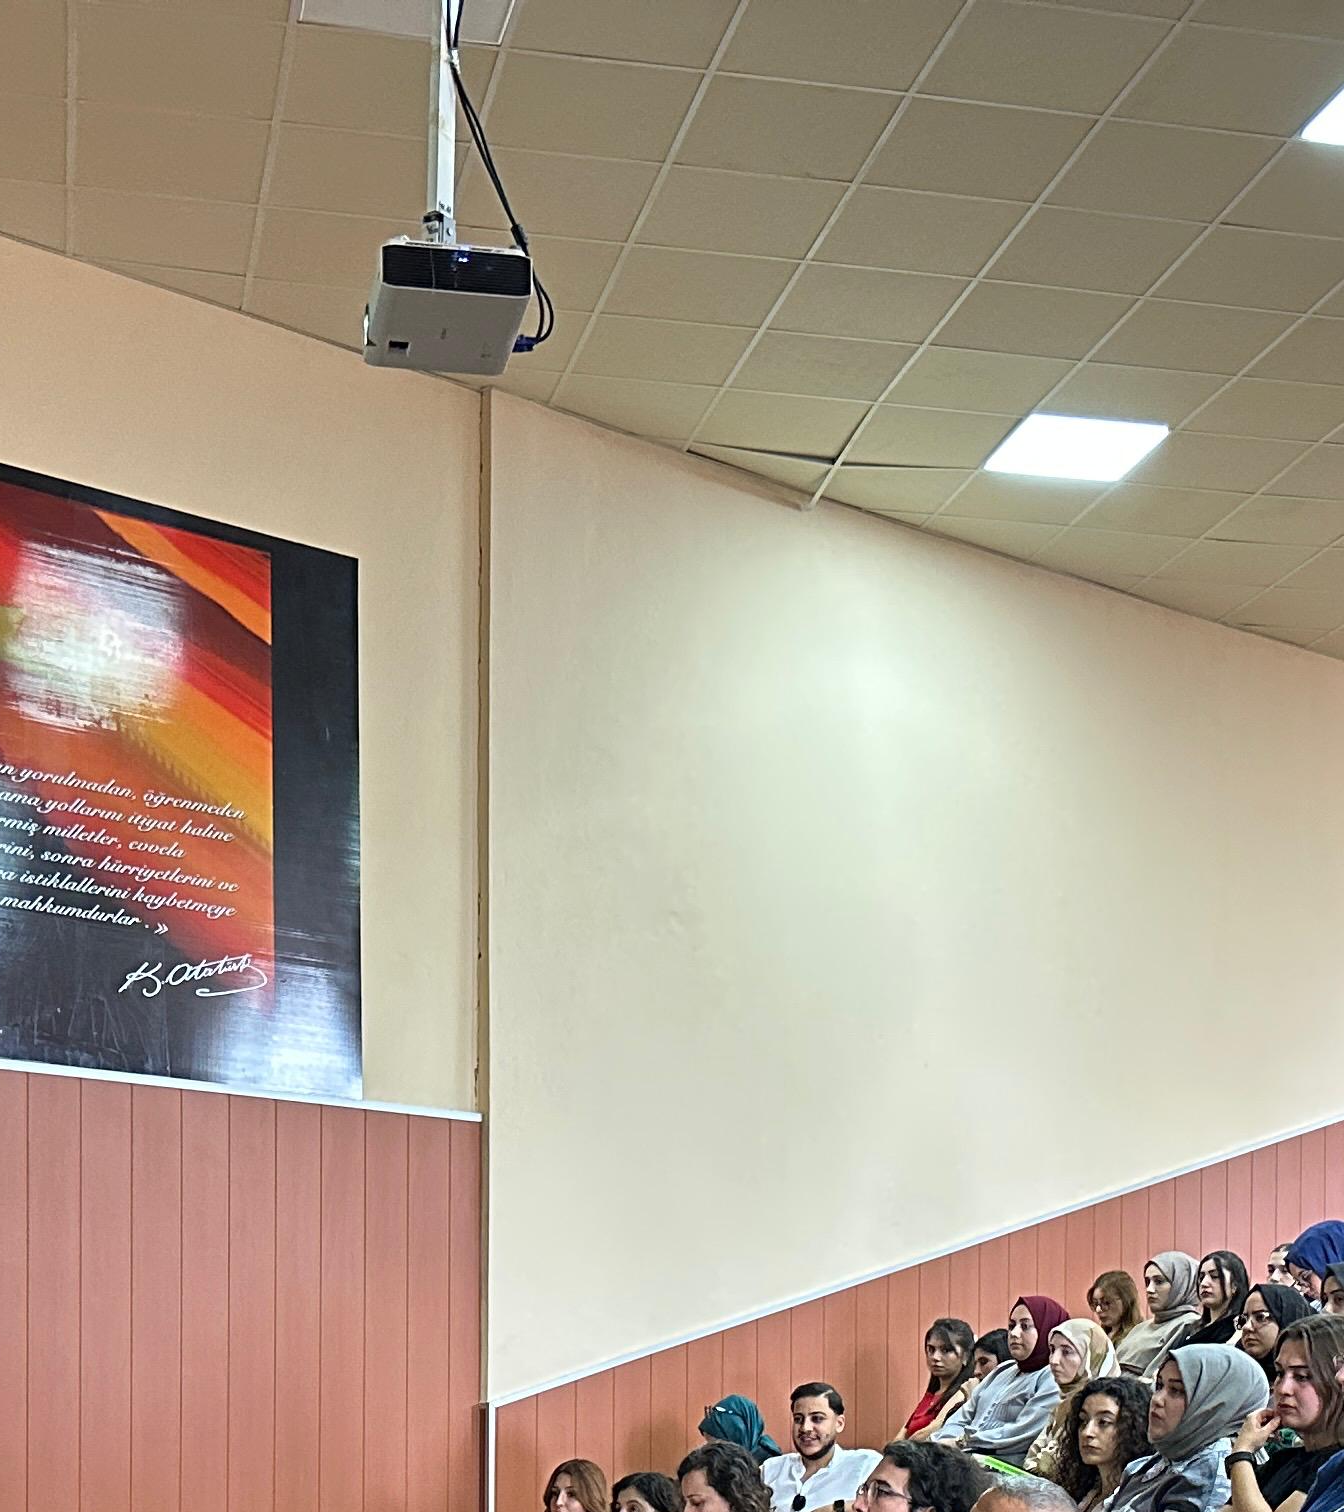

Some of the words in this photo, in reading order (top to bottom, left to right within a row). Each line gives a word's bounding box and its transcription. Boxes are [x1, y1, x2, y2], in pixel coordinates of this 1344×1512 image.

[11, 769, 137, 800] yorulmadan,
[143, 789, 246, 820] öğrenmeden
[37, 798, 126, 822] yollarını
[127, 811, 179, 832] itiyat
[179, 819, 235, 842] haline
[42, 823, 122, 850] milletler,
[128, 840, 186, 859] evvela
[40, 850, 96, 868] sonra
[97, 855, 216, 888] hürriyetlerini
[217, 880, 240, 892] ve
[19, 870, 131, 900] istiklallerini
[132, 886, 237, 920] kaybetmeye
